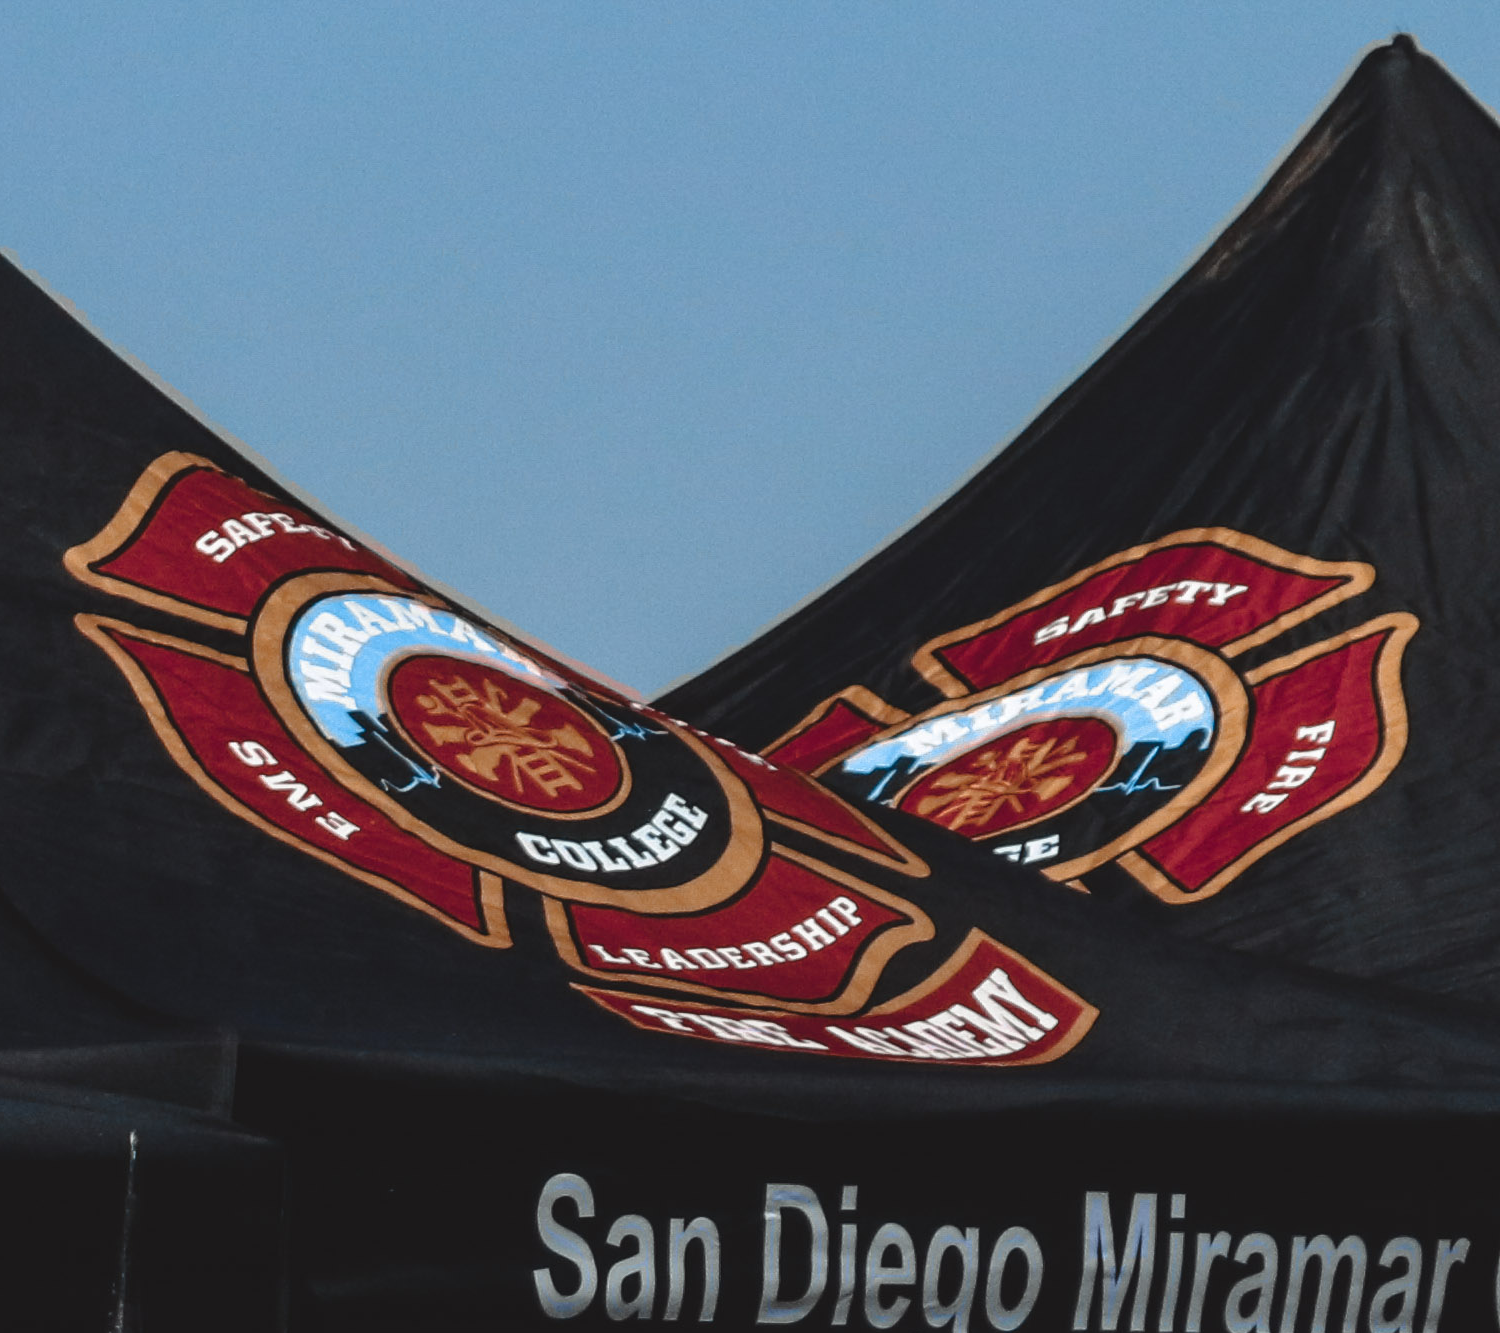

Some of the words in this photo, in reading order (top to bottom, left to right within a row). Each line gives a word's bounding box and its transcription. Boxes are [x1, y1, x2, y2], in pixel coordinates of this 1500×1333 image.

[1033, 579, 1250, 647] SAFETY
[899, 664, 1205, 756] MIRAMAR
[227, 739, 361, 842] EMS
[1241, 719, 1337, 816] FIRE
[516, 792, 712, 873] COLLEGE
[588, 895, 866, 973] LEADERSHIP
[825, 966, 1060, 1060] ACADEMY
[532, 1171, 722, 1323] San
